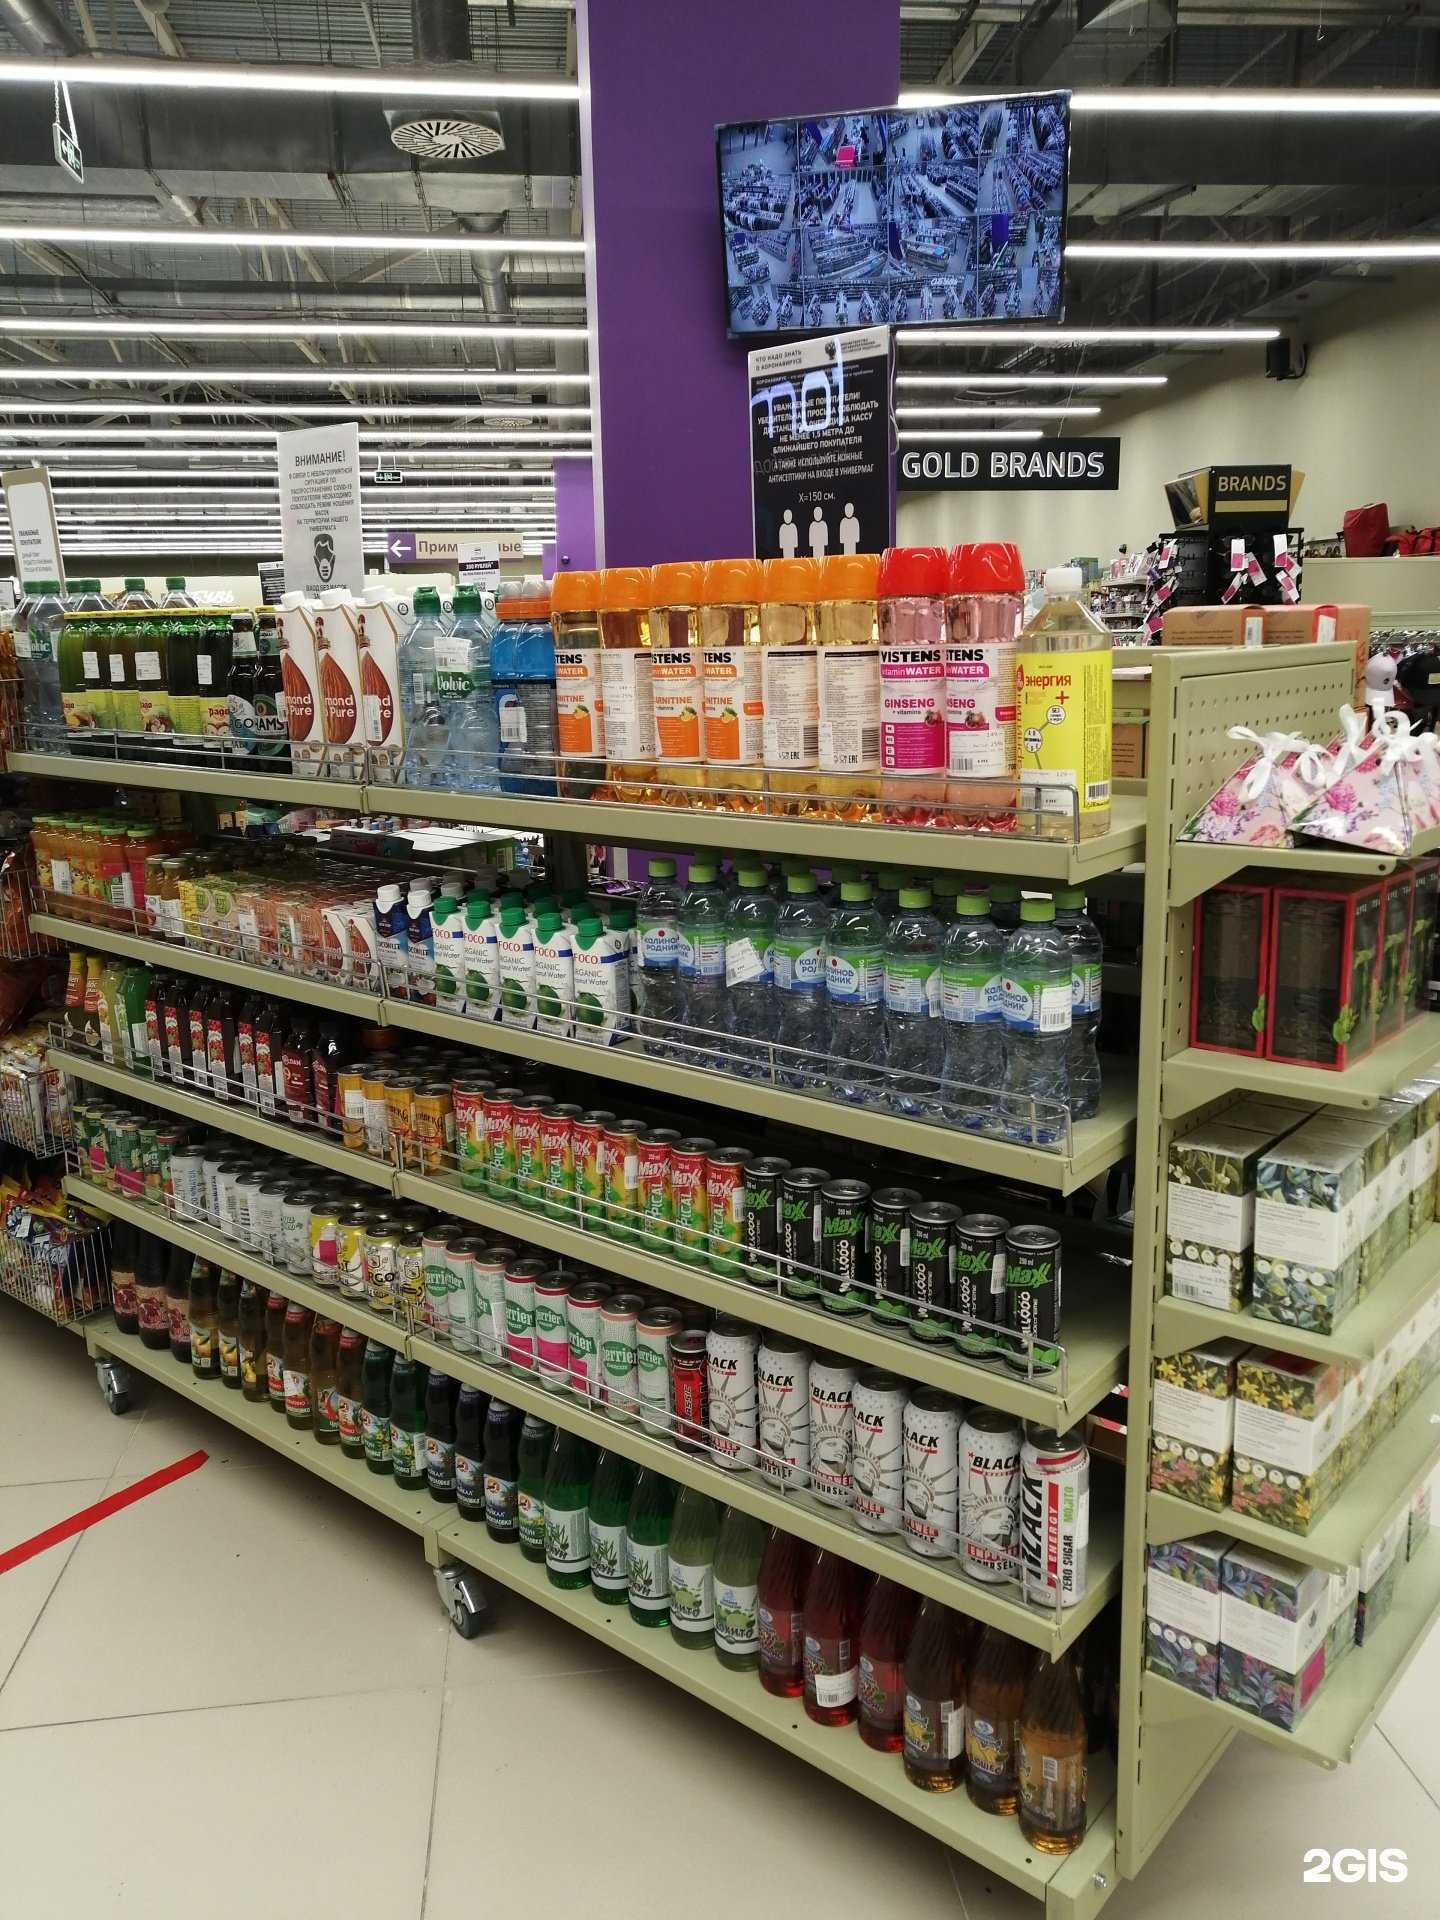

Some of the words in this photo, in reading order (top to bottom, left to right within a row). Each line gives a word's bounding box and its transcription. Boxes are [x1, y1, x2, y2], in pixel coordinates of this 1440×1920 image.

[822, 428, 844, 438] МЕТРА
[845, 426, 855, 435] ДО
[773, 440, 819, 454] БЛИЖАЙШЕГО
[820, 435, 862, 449] ПОКУПАТЕЛЯ
[295, 450, 346, 467] ВНИМАНИЕ!
[902, 451, 978, 479] GOLD
[990, 449, 1105, 478] BRANDS
[840, 463, 874, 475] УНИВЕРМАГ
[1218, 475, 1287, 493] BRANDS
[556, 653, 583, 664] TENS
[652, 652, 691, 664] STENS
[704, 652, 732, 663] TENS
[881, 650, 941, 662] VISTENS
[947, 649, 984, 661] TENS
[882, 666, 942, 676] itaminWATER
[1025, 674, 1071, 690] энергия
[286, 693, 311, 705] mond
[325, 694, 354, 707] mond
[884, 698, 935, 709] GINSENG
[947, 698, 976, 709] SENG
[290, 706, 312, 716] Pure
[331, 707, 355, 719] Pure
[464, 932, 484, 944] FOCO
[499, 941, 521, 953] FOCO
[534, 946, 556, 958] FOCO
[573, 952, 599, 965] FOCO
[575, 968, 602, 978] RGANIC
[506, 1306, 533, 1326] errier
[537, 1308, 562, 1324] errier
[568, 1331, 593, 1351] rrier
[604, 1348, 637, 1364] errier
[639, 1351, 663, 1366] errier
[854, 1406, 885, 1428] LACK
[904, 1425, 940, 1449] LACK
[1021, 1471, 1043, 1580] BLACK
[1063, 1534, 1073, 1566] SUGAR
[1063, 1566, 1073, 1592] ZERO
